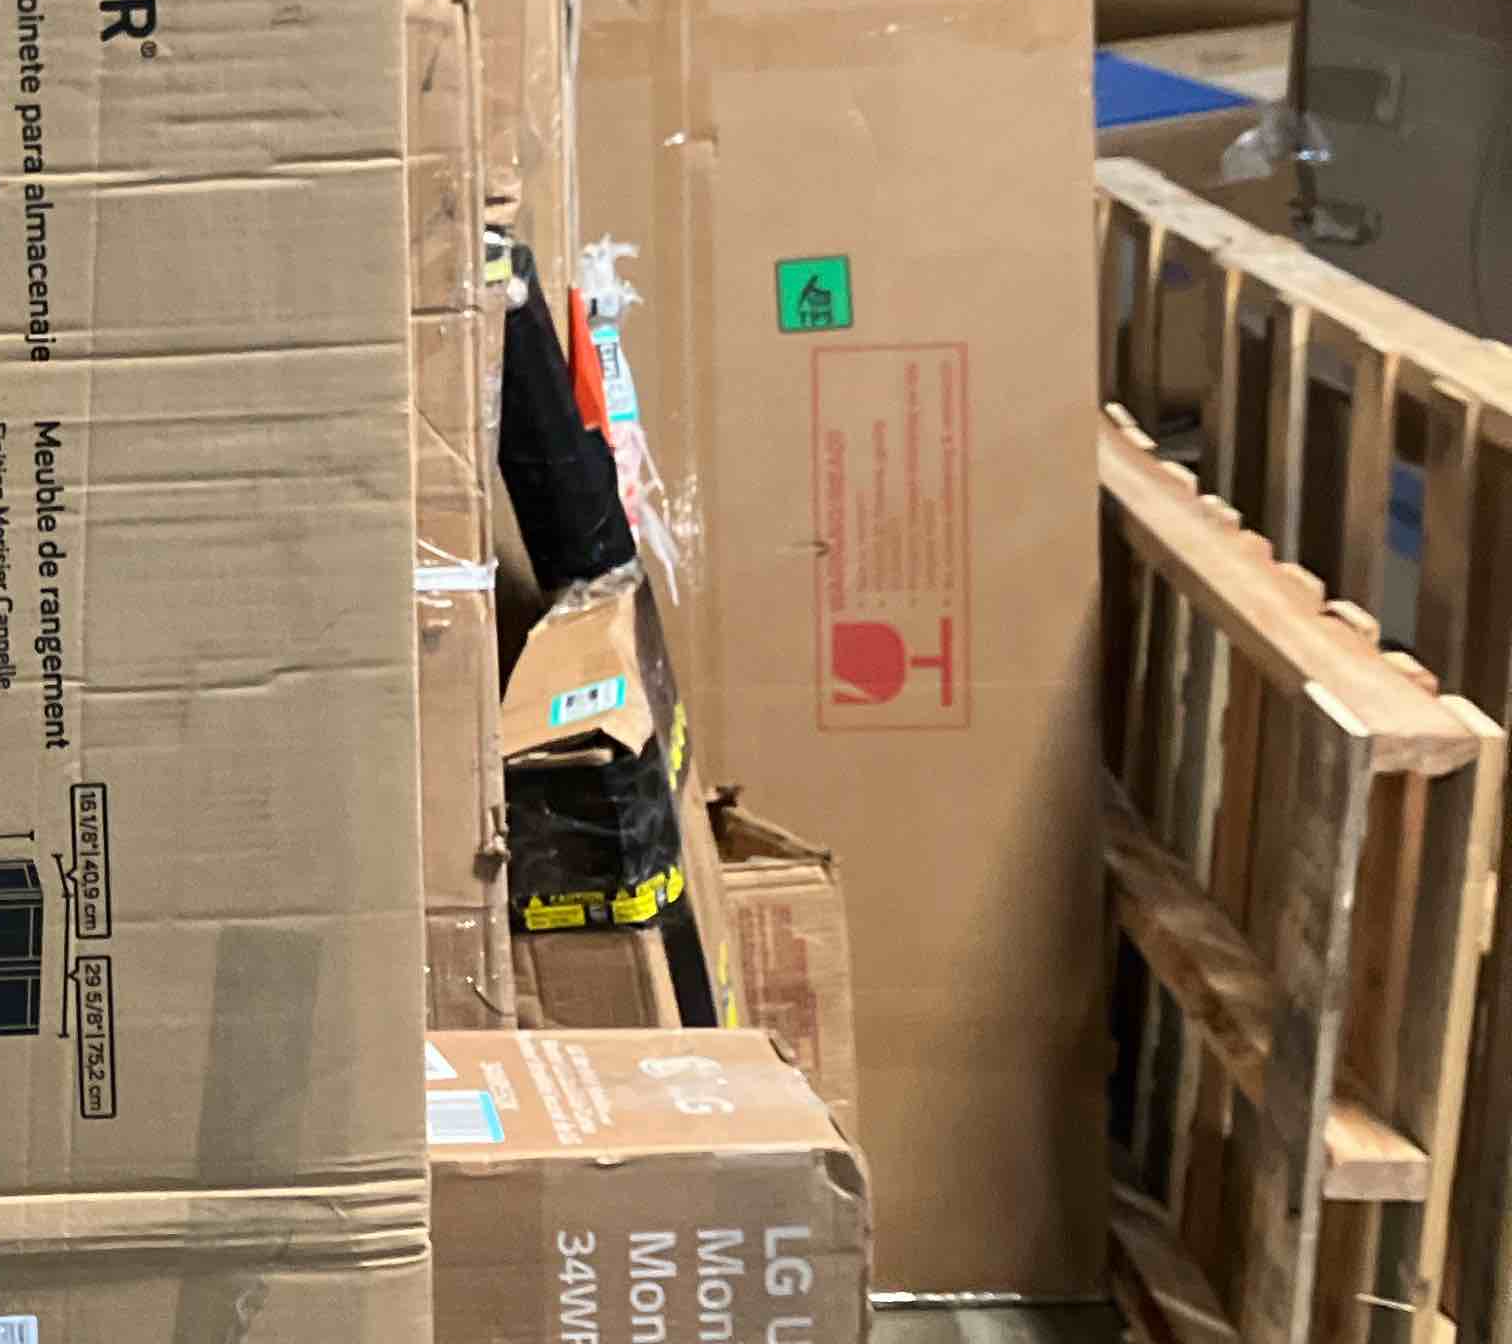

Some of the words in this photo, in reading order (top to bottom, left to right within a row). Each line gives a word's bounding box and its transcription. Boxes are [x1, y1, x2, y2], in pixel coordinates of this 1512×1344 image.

[14, 103, 45, 174] para
[23, 184, 56, 362] almacenaje
[33, 420, 65, 532] Meuble
[38, 541, 67, 578] de
[35, 587, 71, 750] rangement
[84, 903, 97, 931] cm
[84, 962, 102, 987] 29
[89, 1085, 103, 1112] cm
[764, 1224, 814, 1296] LG
